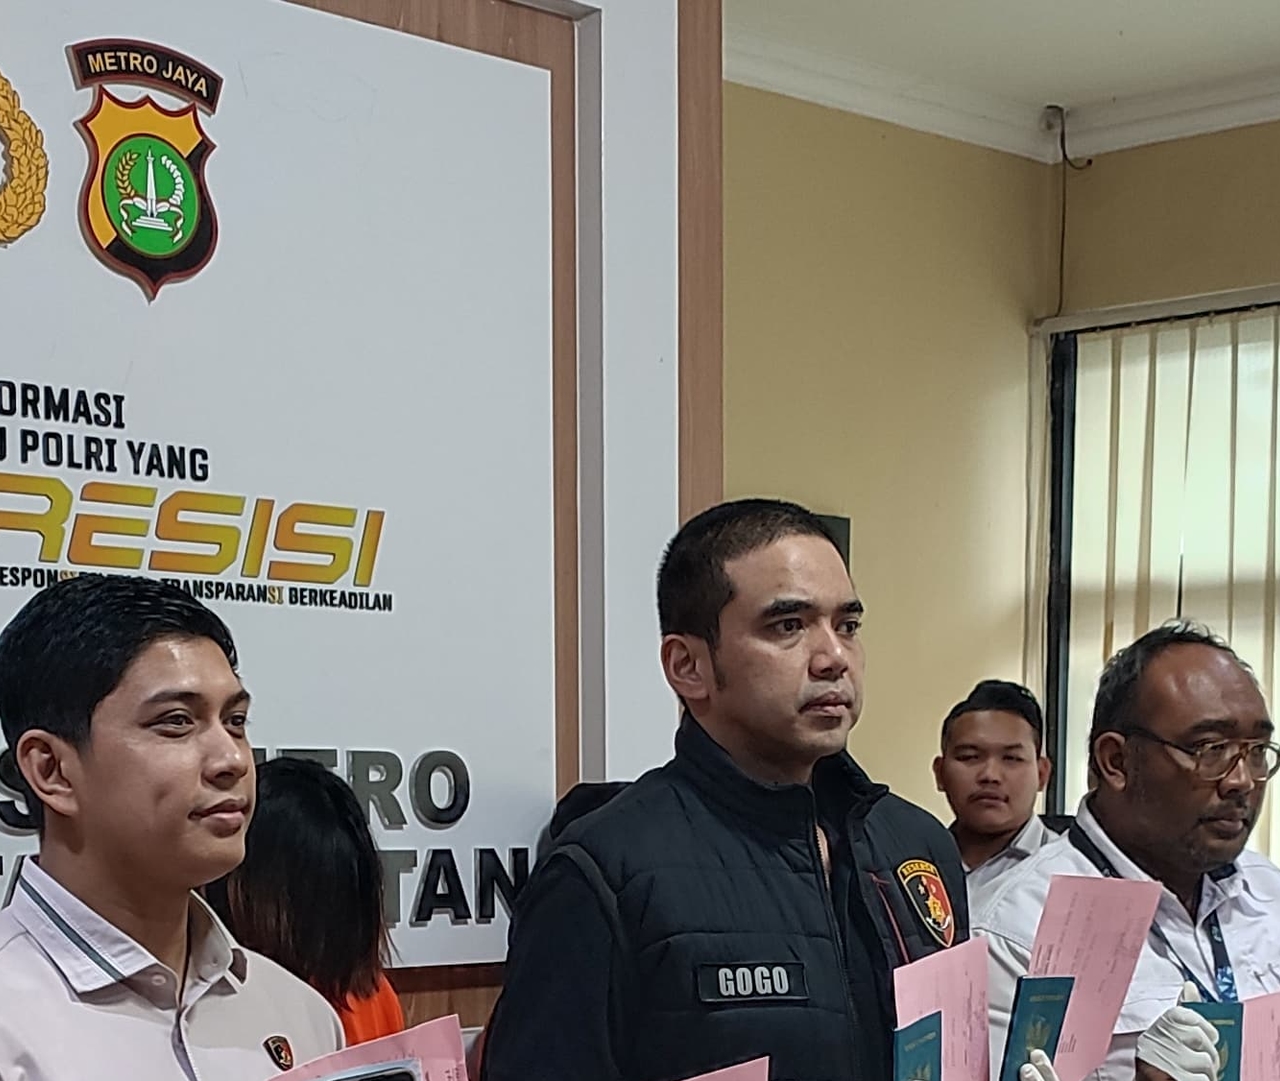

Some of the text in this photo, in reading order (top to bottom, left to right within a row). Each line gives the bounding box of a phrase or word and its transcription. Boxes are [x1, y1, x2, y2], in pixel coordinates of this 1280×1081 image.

[87, 51, 207, 98] METRO JAYA
[20, 429, 118, 473] POLRI
[126, 440, 209, 482] YANG
[288, 586, 393, 611] BERKEADILAN
[718, 966, 789, 996] GOGO
